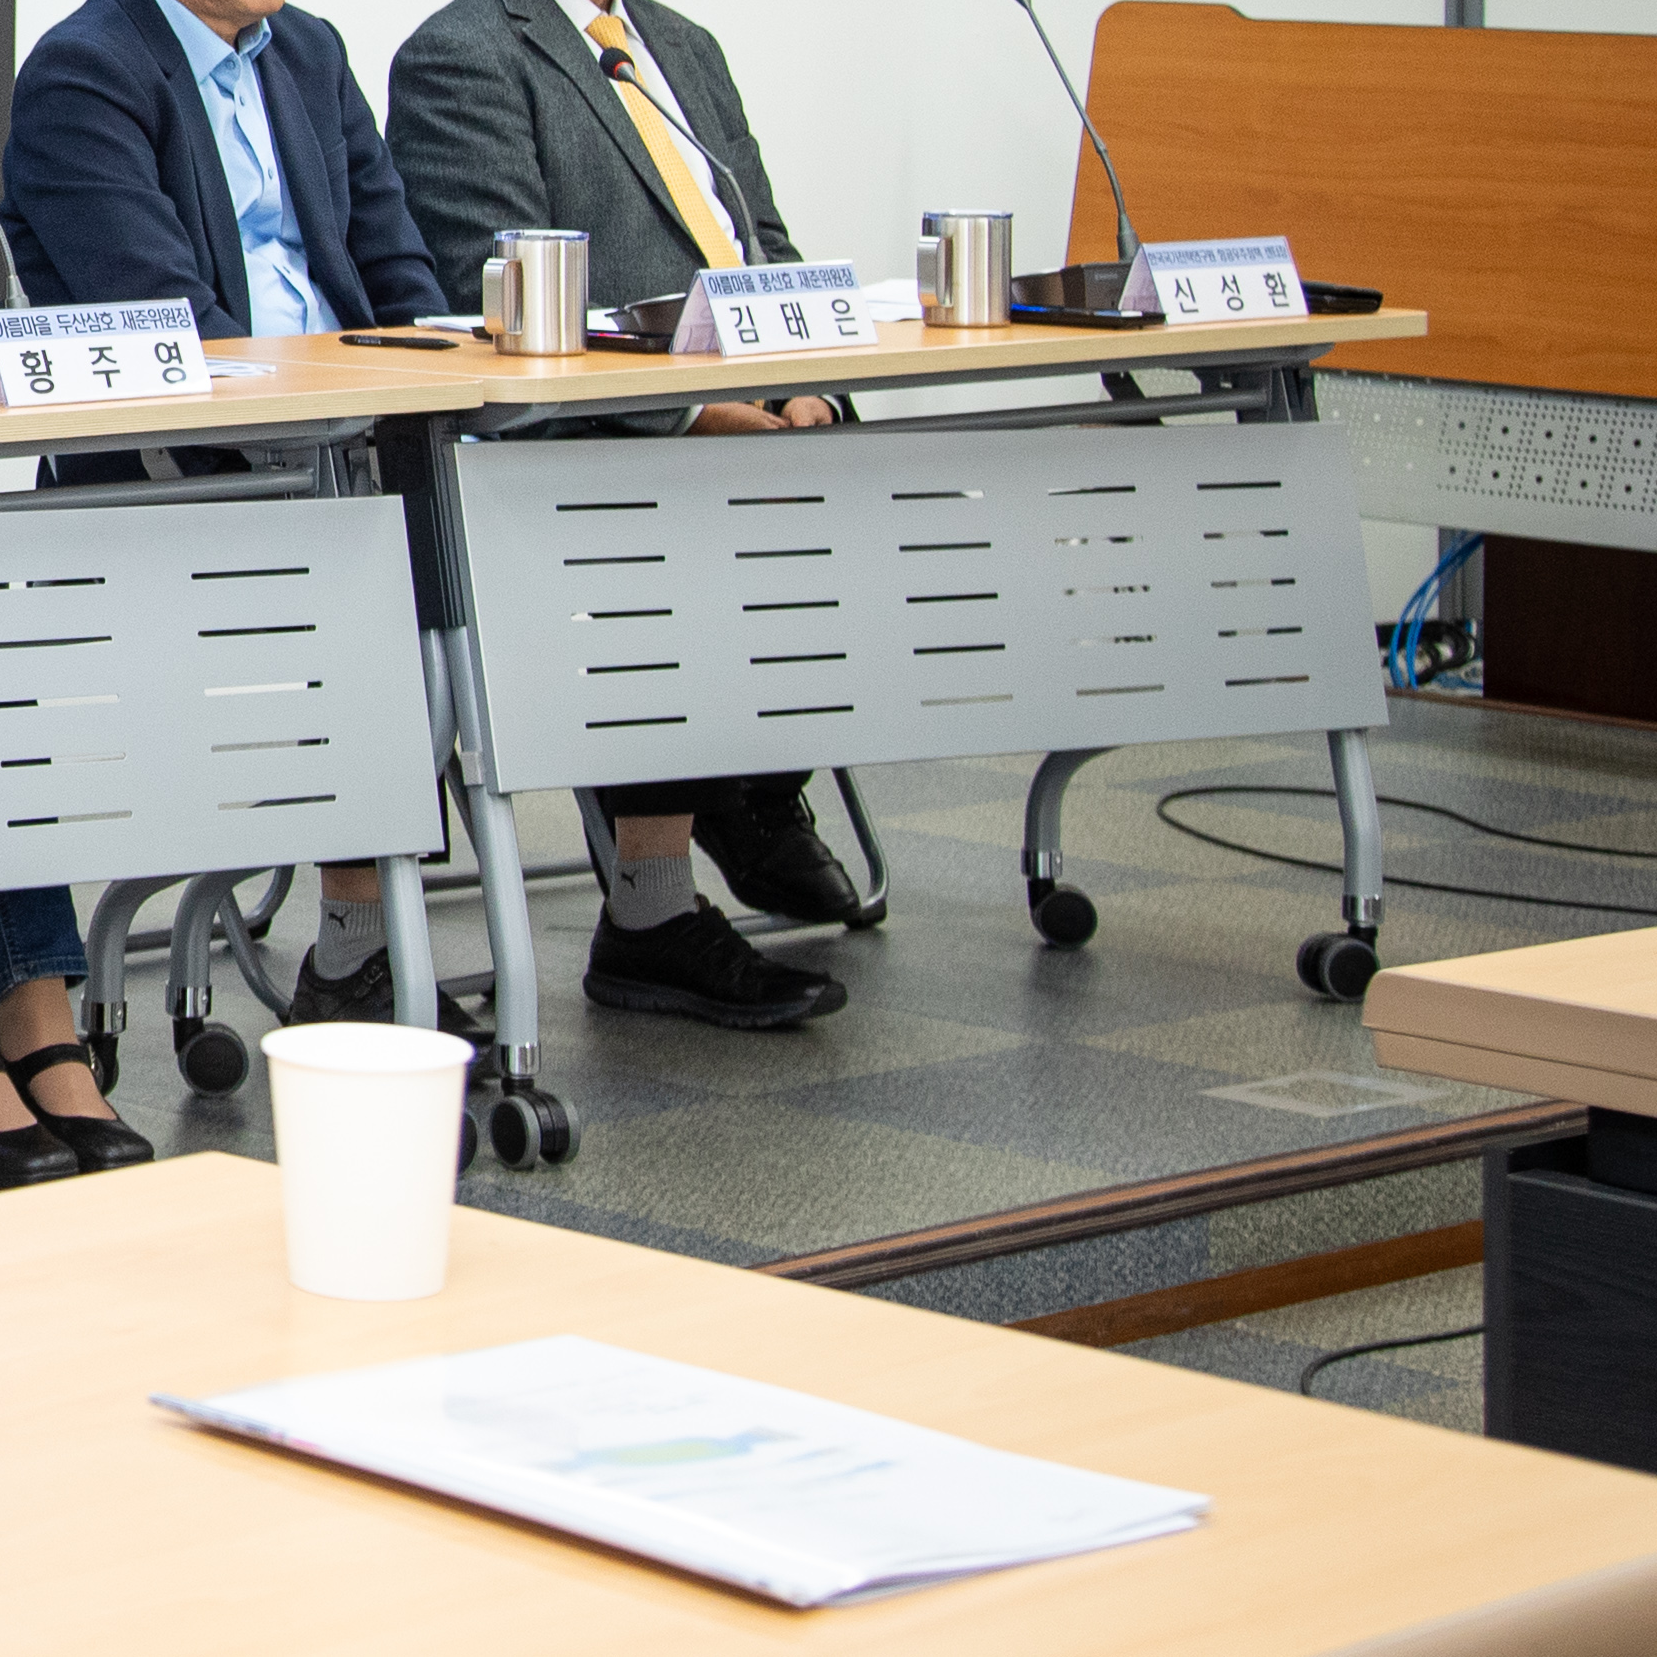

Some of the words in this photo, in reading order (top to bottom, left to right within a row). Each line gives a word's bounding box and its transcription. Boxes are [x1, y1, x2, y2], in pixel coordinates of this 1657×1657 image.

[708, 273, 755, 295] 아름마을
[759, 271, 795, 293] 풍선효
[796, 268, 855, 290] 재준위원장
[56, 311, 117, 334] 두산삼호
[119, 307, 192, 330] 재준위원장
